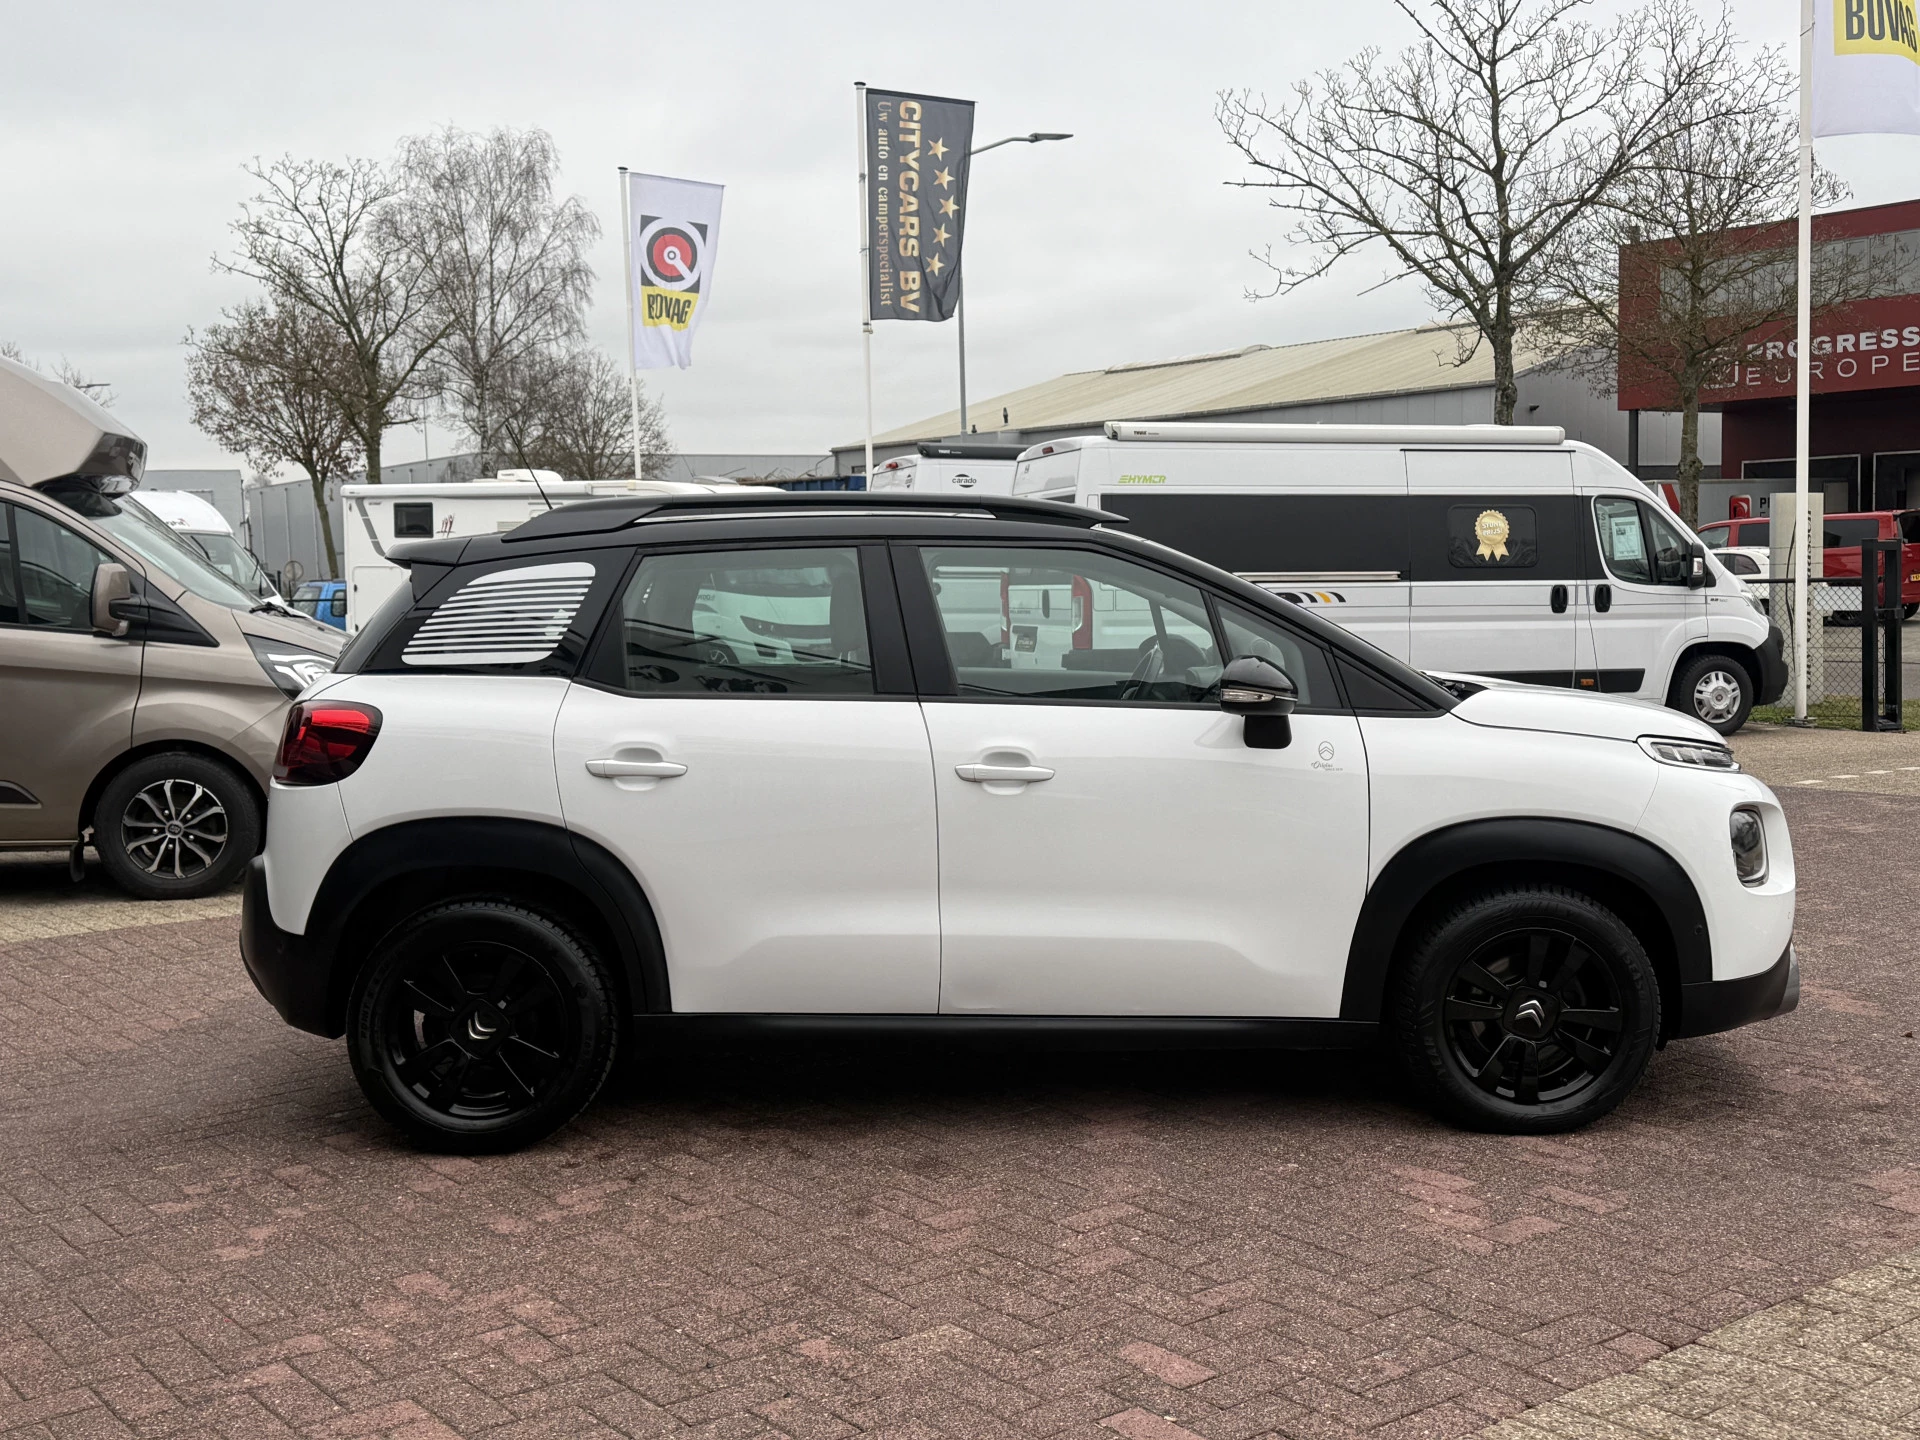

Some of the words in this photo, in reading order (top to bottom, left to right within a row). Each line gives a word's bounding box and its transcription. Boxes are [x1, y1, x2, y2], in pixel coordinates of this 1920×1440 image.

[1845, 0, 1918, 53] BOVAG
[877, 101, 892, 122] Uw
[878, 128, 891, 159] auto
[878, 166, 889, 181] en
[899, 101, 922, 257] CITYCARS
[876, 187, 894, 305] camperspecialist
[899, 270, 921, 313] BV
[647, 293, 692, 324] BOVAG
[952, 476, 977, 484] carado
[1119, 474, 1167, 484] HYMER
